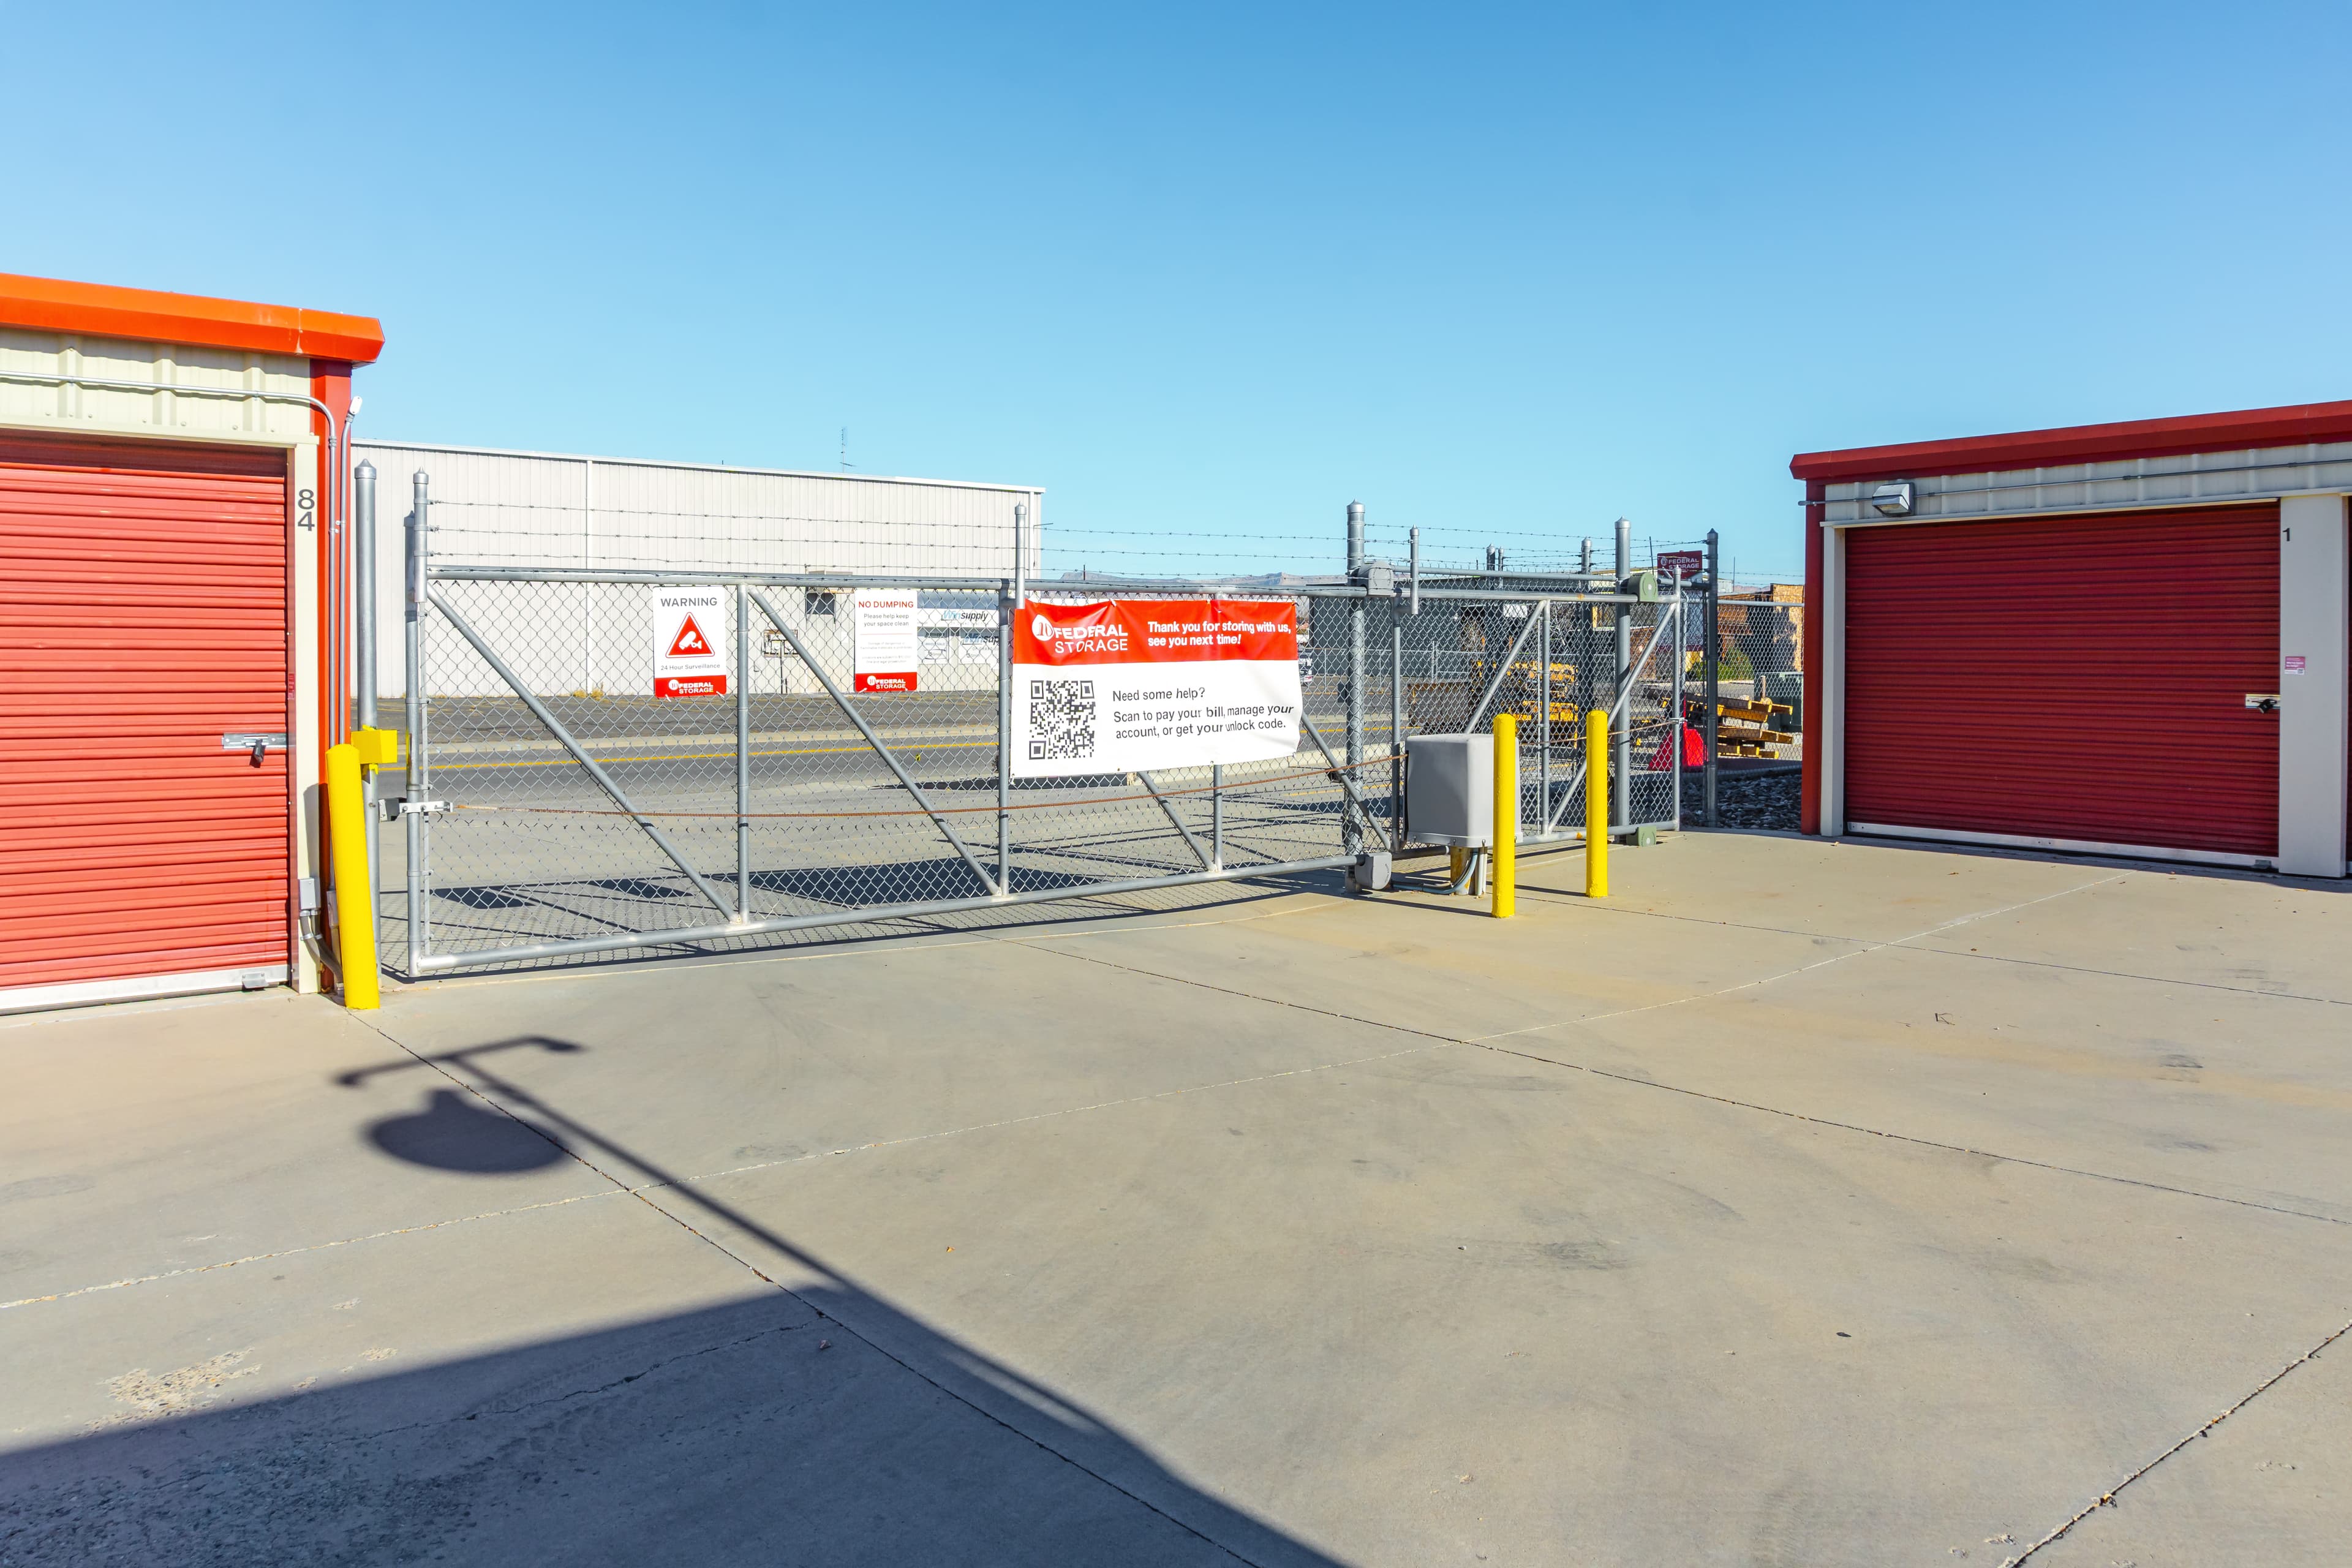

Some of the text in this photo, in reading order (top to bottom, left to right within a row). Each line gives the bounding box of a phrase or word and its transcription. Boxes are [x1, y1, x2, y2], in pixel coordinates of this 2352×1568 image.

[298, 489, 315, 532] 84
[2282, 527, 2290, 541] 1
[660, 597, 717, 607] WARNING
[943, 611, 989, 622] Winsupply
[1053, 624, 1128, 639] FEDERAL
[1147, 621, 1291, 634] Thank you for storing with us,
[964, 633, 999, 645] Winsup
[1148, 634, 1242, 648] see you next time!
[1055, 639, 1128, 654] STORAGE
[1112, 687, 1205, 701] Need some help?
[1114, 705, 1294, 722] Scan to pay your bill, manage your
[1116, 718, 1286, 739] account, or get your unlock code.
